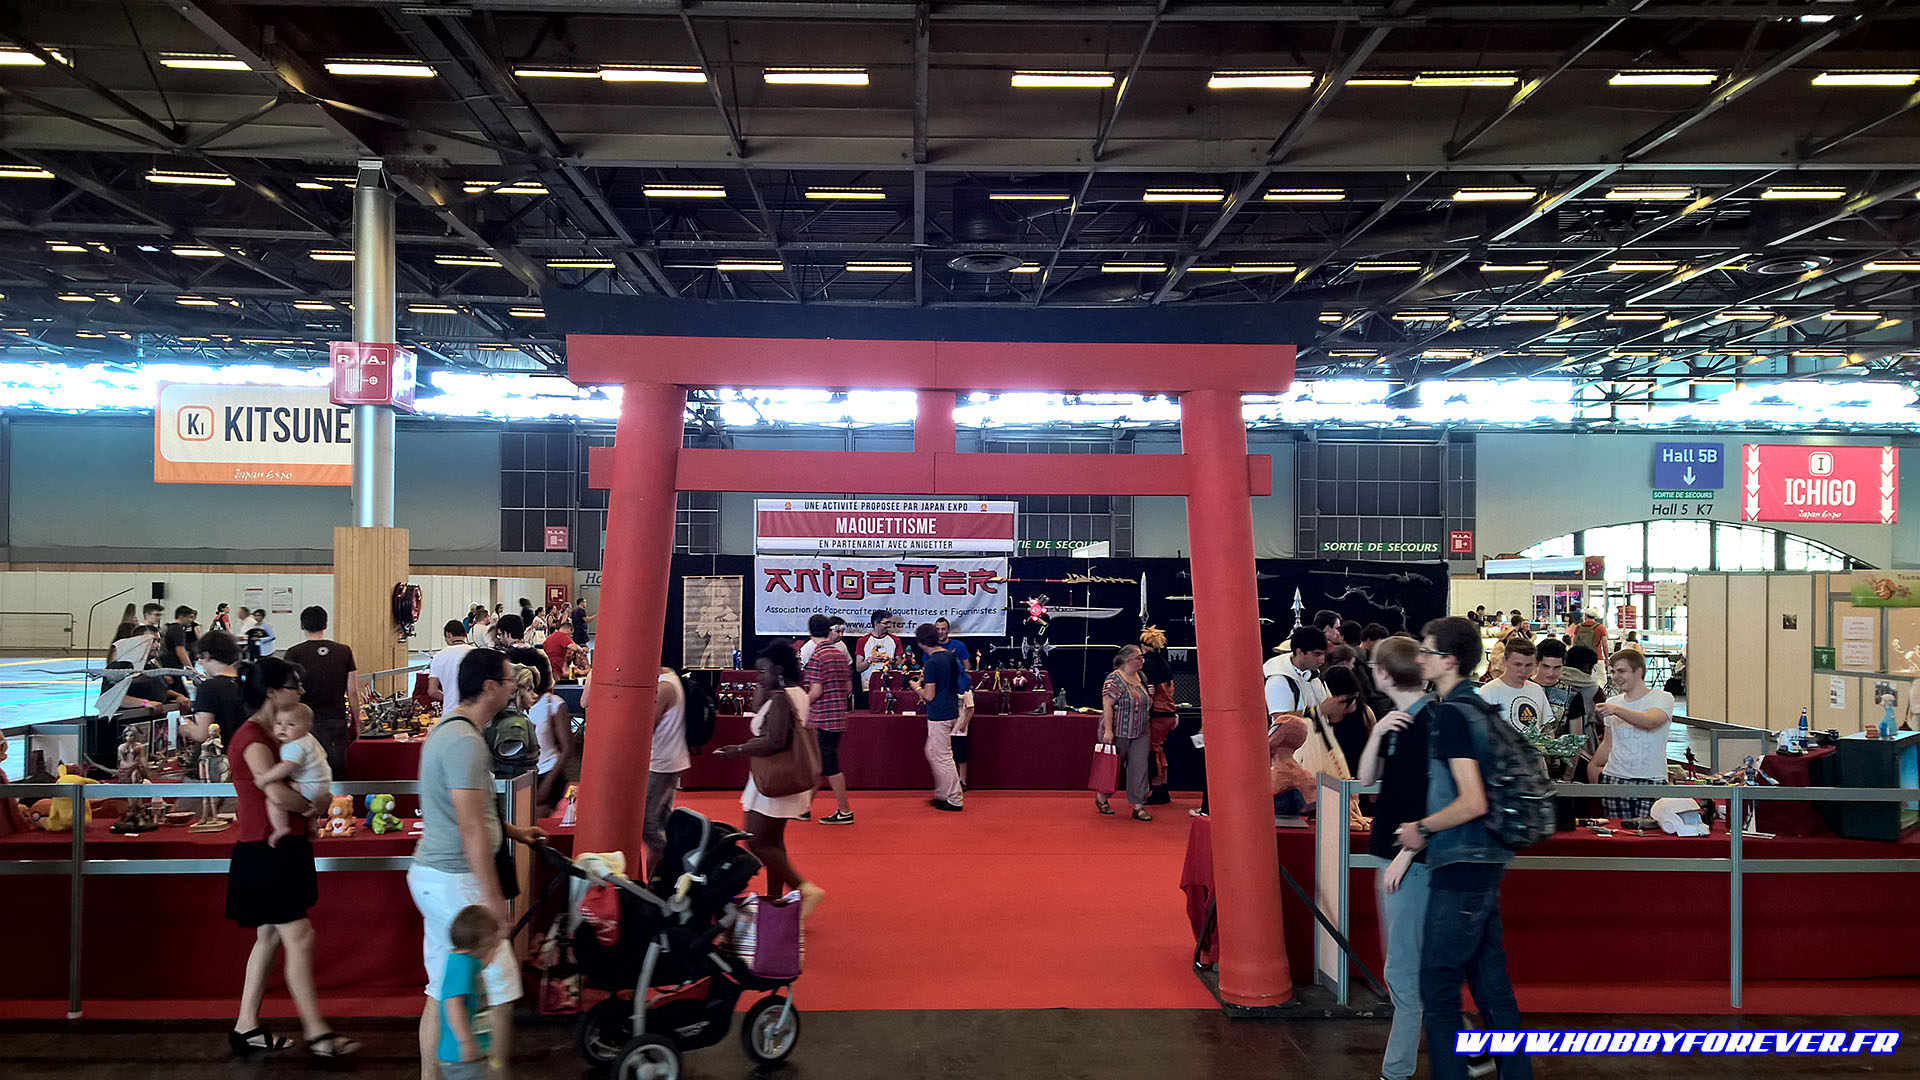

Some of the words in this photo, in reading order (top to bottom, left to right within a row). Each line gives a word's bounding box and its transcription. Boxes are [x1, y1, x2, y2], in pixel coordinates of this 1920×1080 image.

[224, 406, 351, 443] KITSUNE
[1662, 449, 1694, 463] Hall
[1698, 449, 1718, 463] 5B
[233, 468, 264, 480] Japan
[266, 469, 293, 480] Expo
[1784, 478, 1856, 506] ICHIGO
[804, 501, 820, 510] UNE
[903, 502, 918, 511] PAR
[920, 502, 945, 511] JAPAN
[947, 502, 968, 512] EXPO
[1651, 503, 1677, 515] Hall
[1680, 503, 1689, 515] 5
[1696, 503, 1714, 515] K7
[1798, 509, 1820, 519] Japan
[835, 517, 937, 535] MAQUETTISME
[819, 540, 830, 549] EN
[832, 540, 885, 549] PARTENARIAT
[887, 540, 908, 549] AVEC
[910, 540, 953, 550] ANIGETTER
[1036, 540, 1051, 549] DE
[1323, 542, 1364, 551] SORTIE
[1368, 542, 1383, 551] DE
[1387, 543, 1438, 552] SECOURS
[765, 605, 811, 614] Association
[812, 605, 823, 614] de
[939, 607, 948, 615] et
[950, 607, 997, 618] Figurinistes
